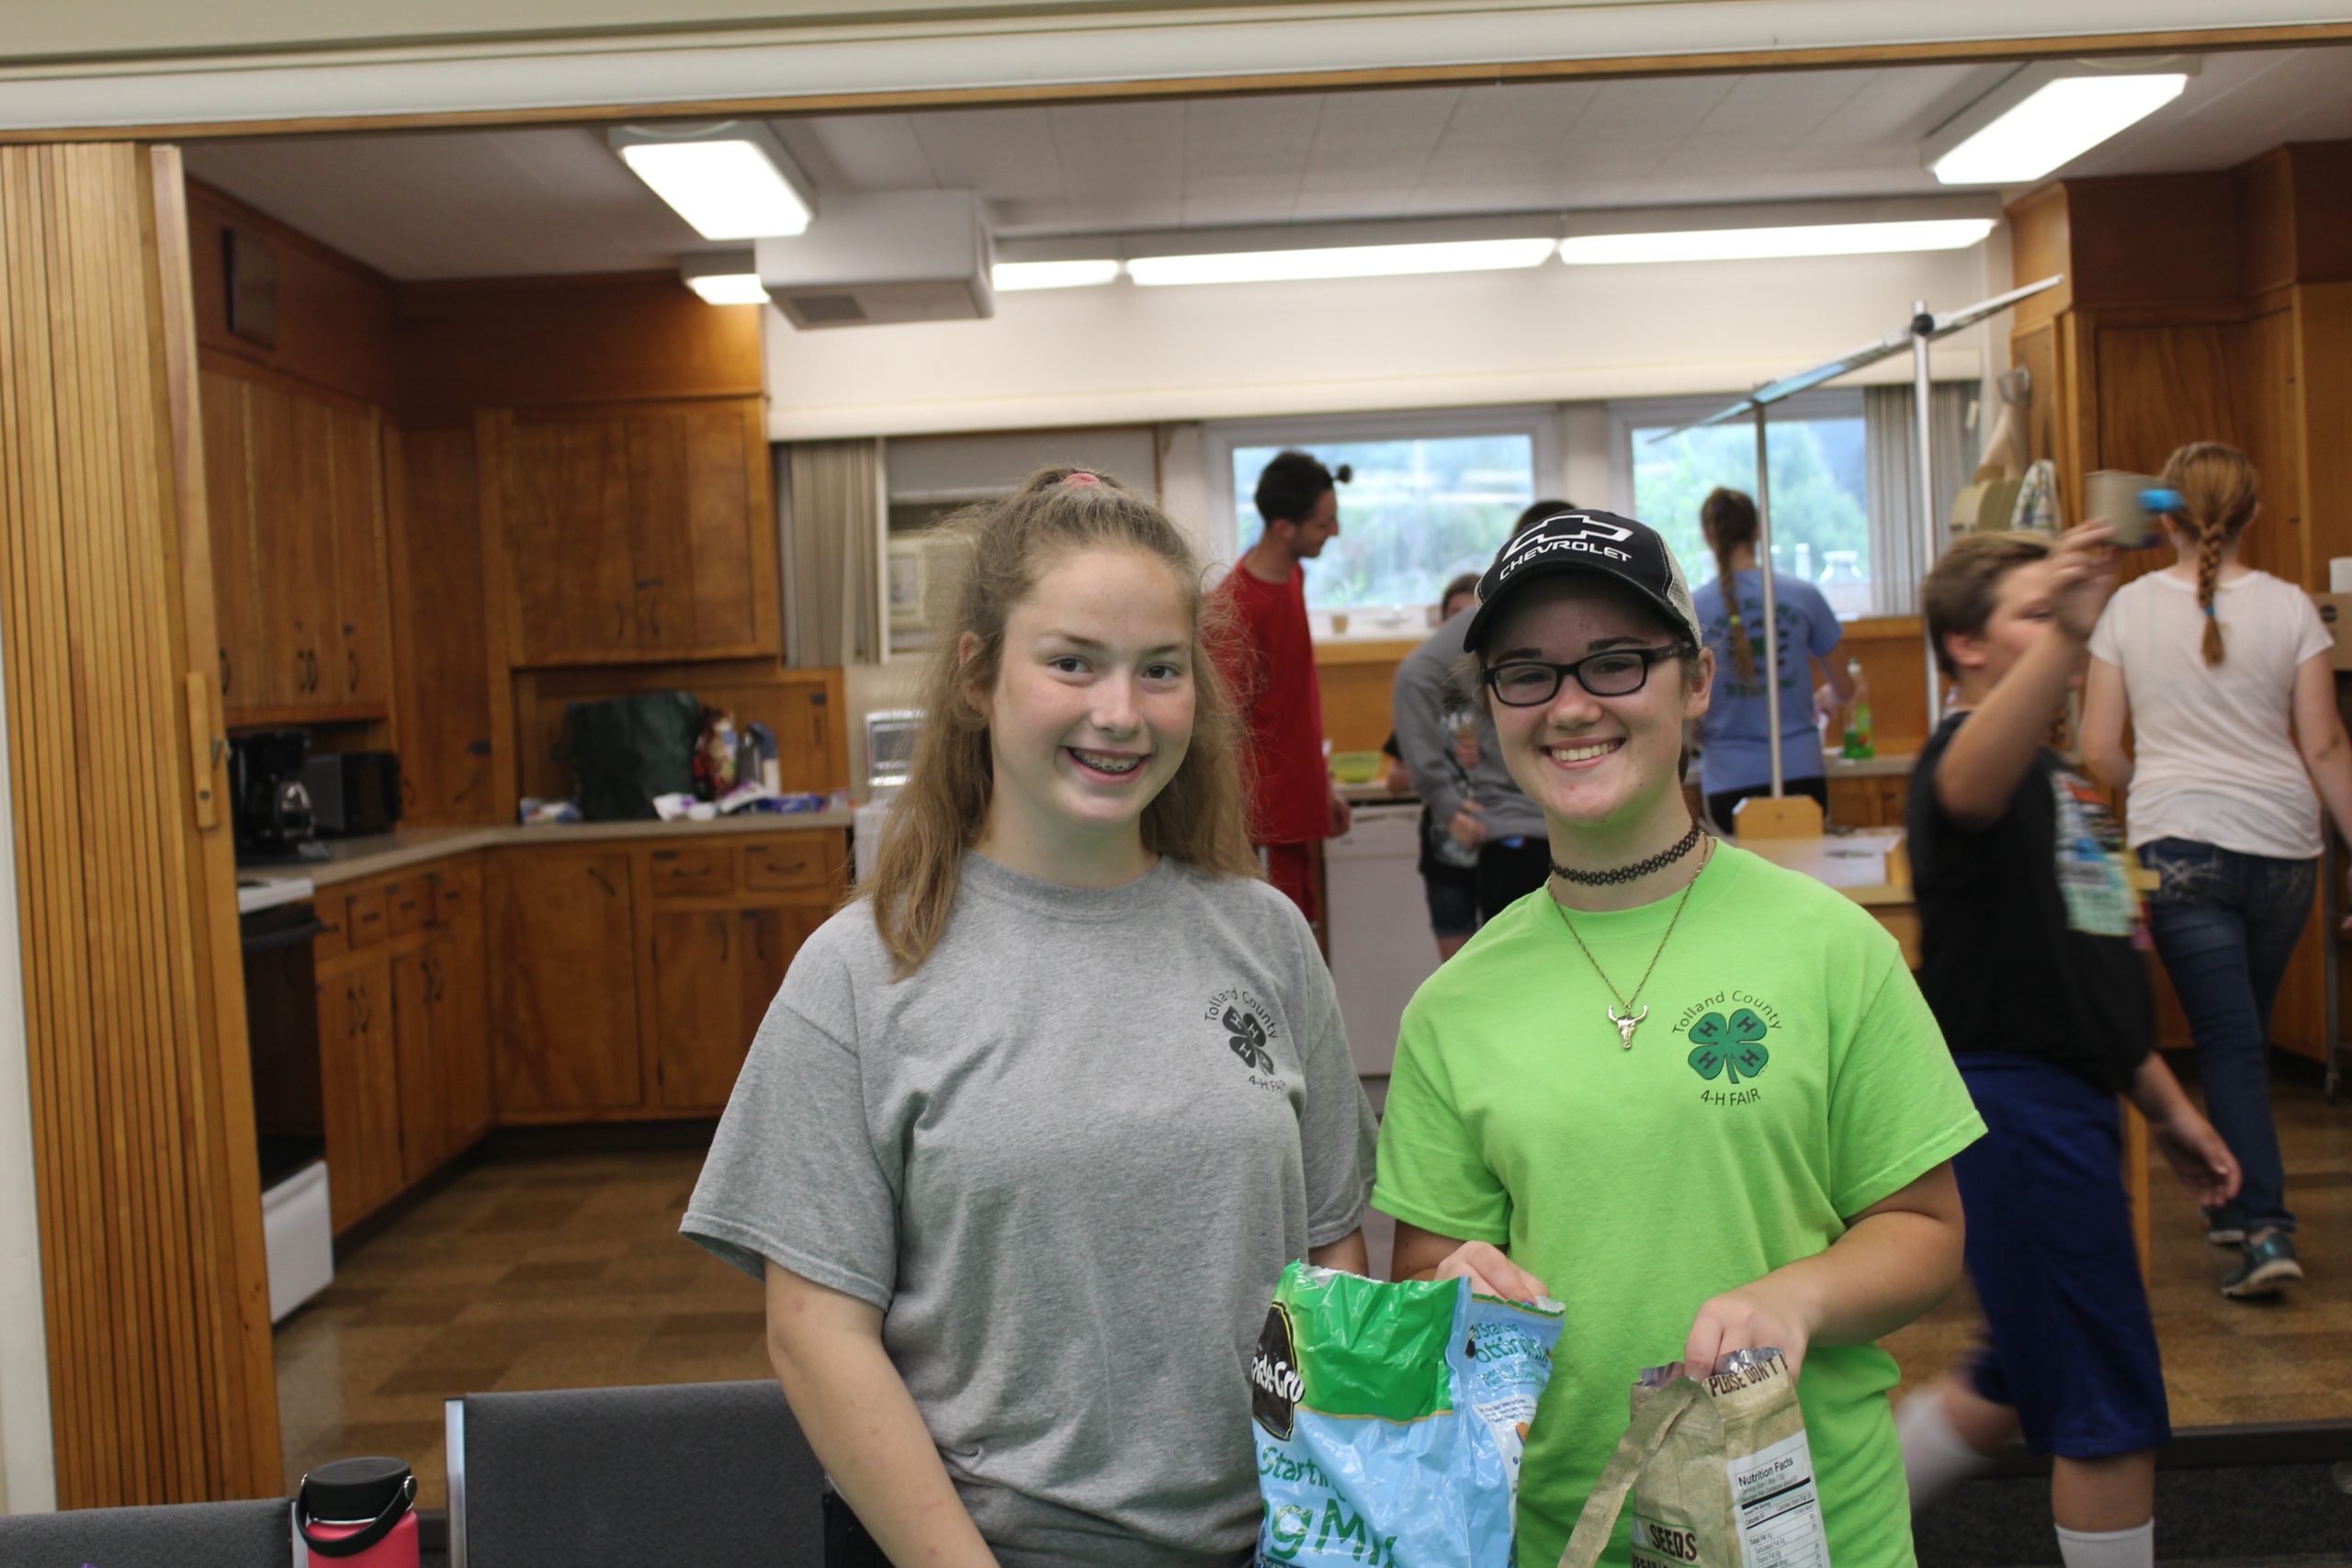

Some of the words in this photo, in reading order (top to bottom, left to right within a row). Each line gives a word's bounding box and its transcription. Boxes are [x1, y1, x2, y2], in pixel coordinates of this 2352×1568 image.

[1499, 539, 1633, 581] CHEVROLET
[1204, 987, 1238, 1021] Tolland
[1242, 990, 1279, 1039] County
[1672, 991, 1725, 1035] Tolland
[1732, 990, 1781, 1031] County
[1700, 1089, 1725, 1106] 4-H
[1730, 1088, 1761, 1106] FAIR
[1743, 1357, 1779, 1384] DON'T
[1737, 1466, 1774, 1487] Nutrition
[1774, 1457, 1794, 1472] Facts
[1649, 1523, 1698, 1562] SEEDS
